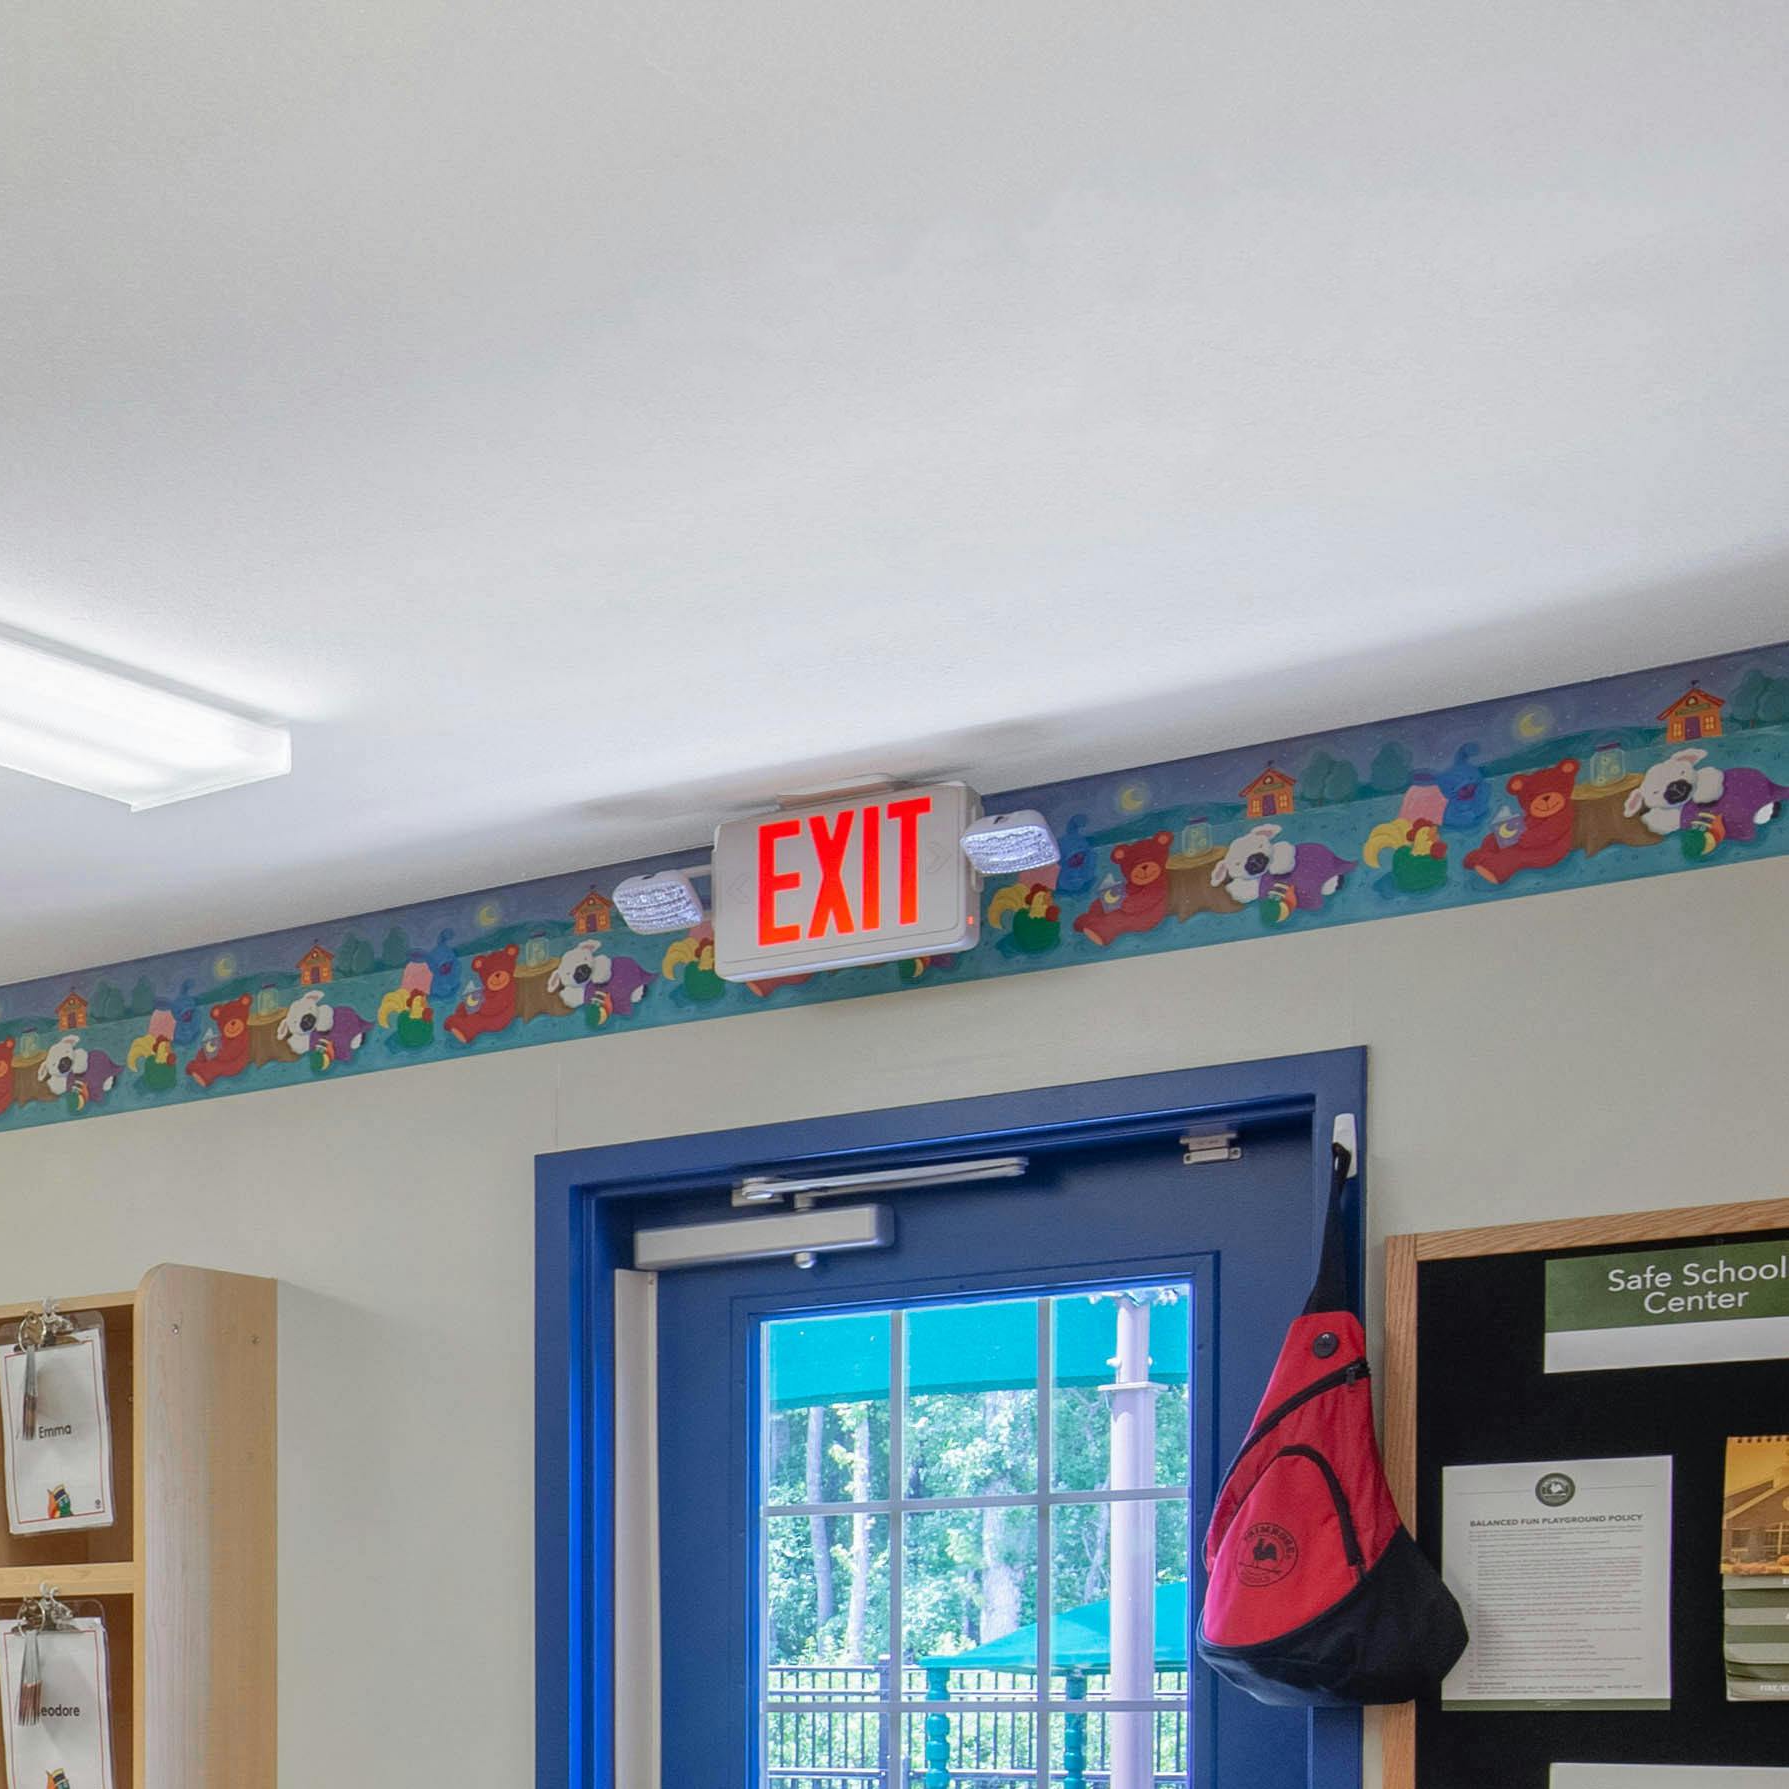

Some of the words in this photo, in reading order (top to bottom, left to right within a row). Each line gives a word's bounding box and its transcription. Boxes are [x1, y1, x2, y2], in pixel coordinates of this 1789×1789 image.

[758, 796, 931, 946] EXIT
[1608, 1265, 1672, 1292] Safe
[1682, 1255, 1787, 1286] School
[1644, 1290, 1749, 1314] Center
[38, 1424, 72, 1439] Emma
[1470, 1519, 1518, 1527] BALANCED
[1521, 1517, 1540, 1525] FUN
[1542, 1515, 1606, 1524] PLAYGROUND
[1608, 1514, 1643, 1522] POLICY
[40, 1704, 80, 1717] eodore
